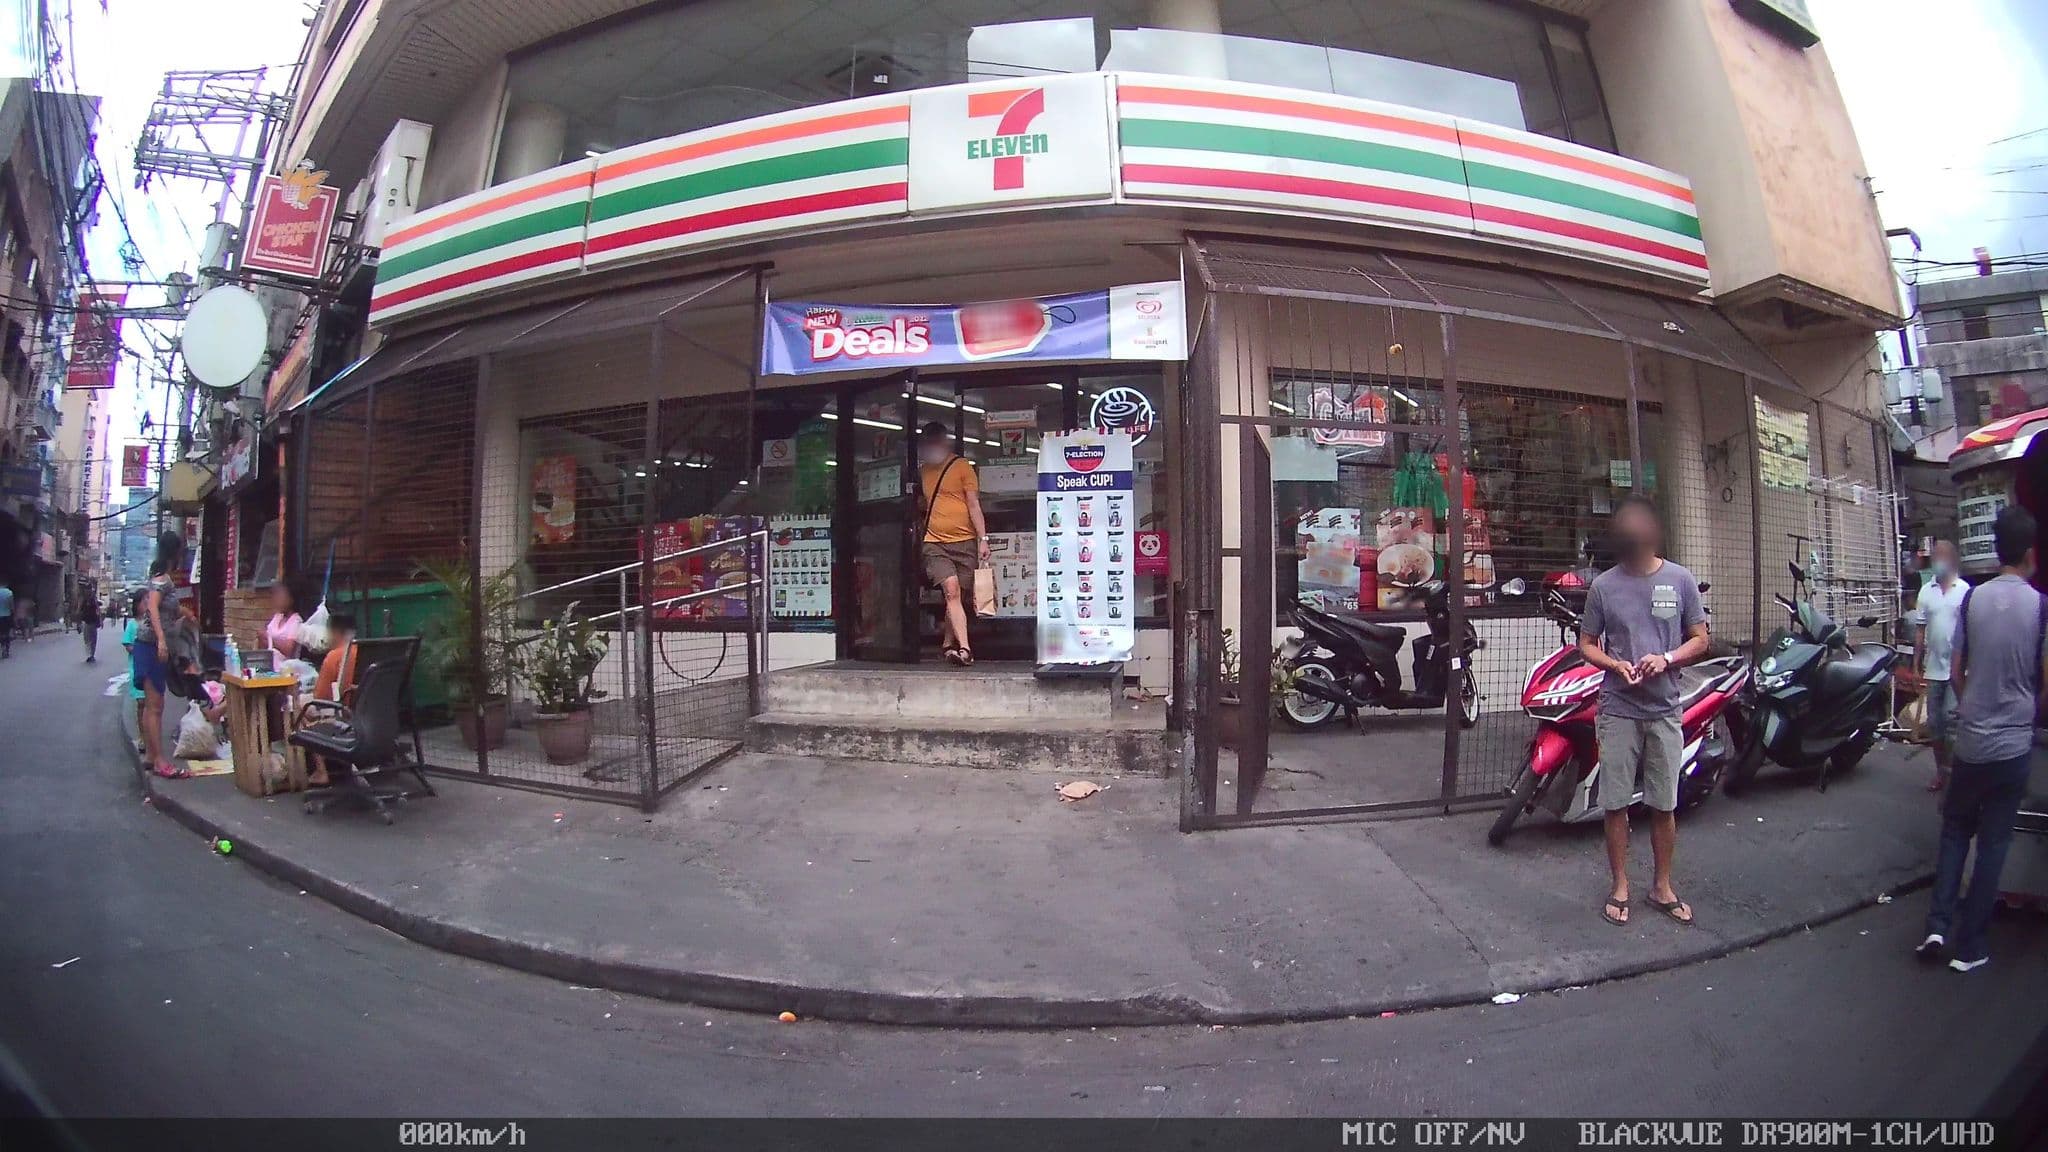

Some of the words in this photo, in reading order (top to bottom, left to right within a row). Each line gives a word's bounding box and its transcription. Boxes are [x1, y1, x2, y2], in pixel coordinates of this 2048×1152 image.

[968, 87, 1044, 190] 7
[262, 221, 321, 237] CHICKEN
[271, 234, 305, 248] STAR
[807, 313, 837, 327] NEW
[813, 318, 929, 359] Deals
[1065, 450, 1104, 458] 7-ELECTION
[1057, 474, 1088, 490] Speak
[1090, 473, 1114, 487] CUP!
